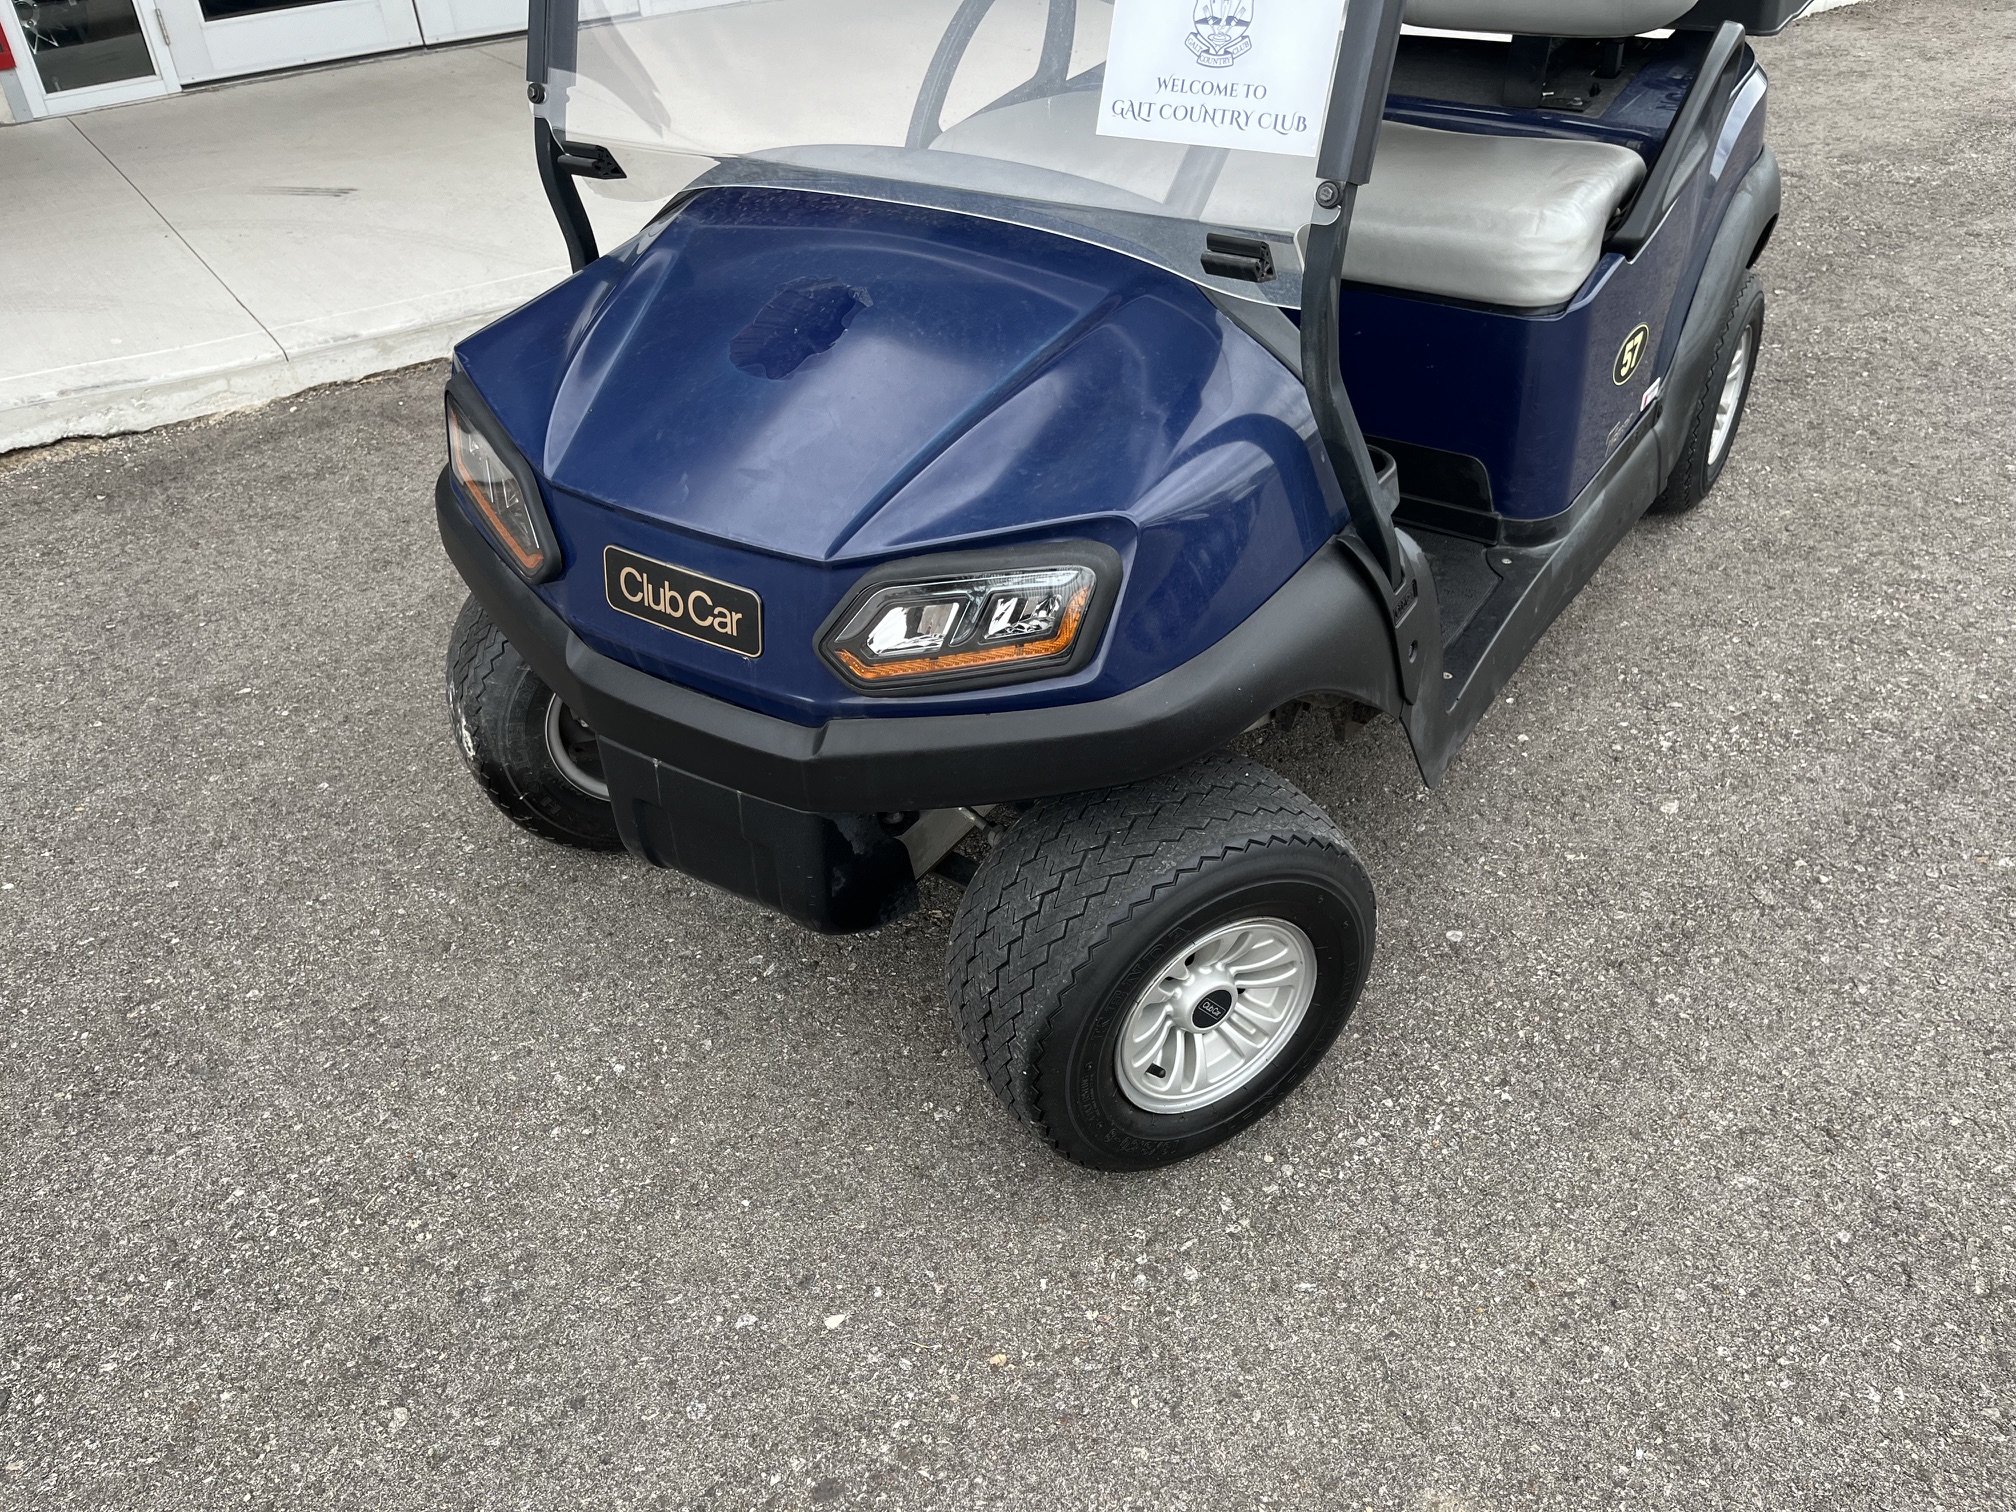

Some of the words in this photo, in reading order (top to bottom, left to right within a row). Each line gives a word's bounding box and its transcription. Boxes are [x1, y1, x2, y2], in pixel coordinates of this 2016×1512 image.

[1188, 38, 1203, 53] GALT
[1200, 55, 1232, 65] COUNTRY
[1232, 41, 1250, 55] CLUB
[1155, 74, 1238, 98] WELCOME
[1243, 84, 1267, 100] TO
[1111, 99, 1156, 122] GALT
[1159, 102, 1256, 131] COUNTRY
[1257, 111, 1308, 135] CLUB
[1620, 330, 1644, 377] 57
[619, 566, 684, 618] Club
[687, 590, 743, 637] Car
[1091, 926, 1191, 1040] KENDA
